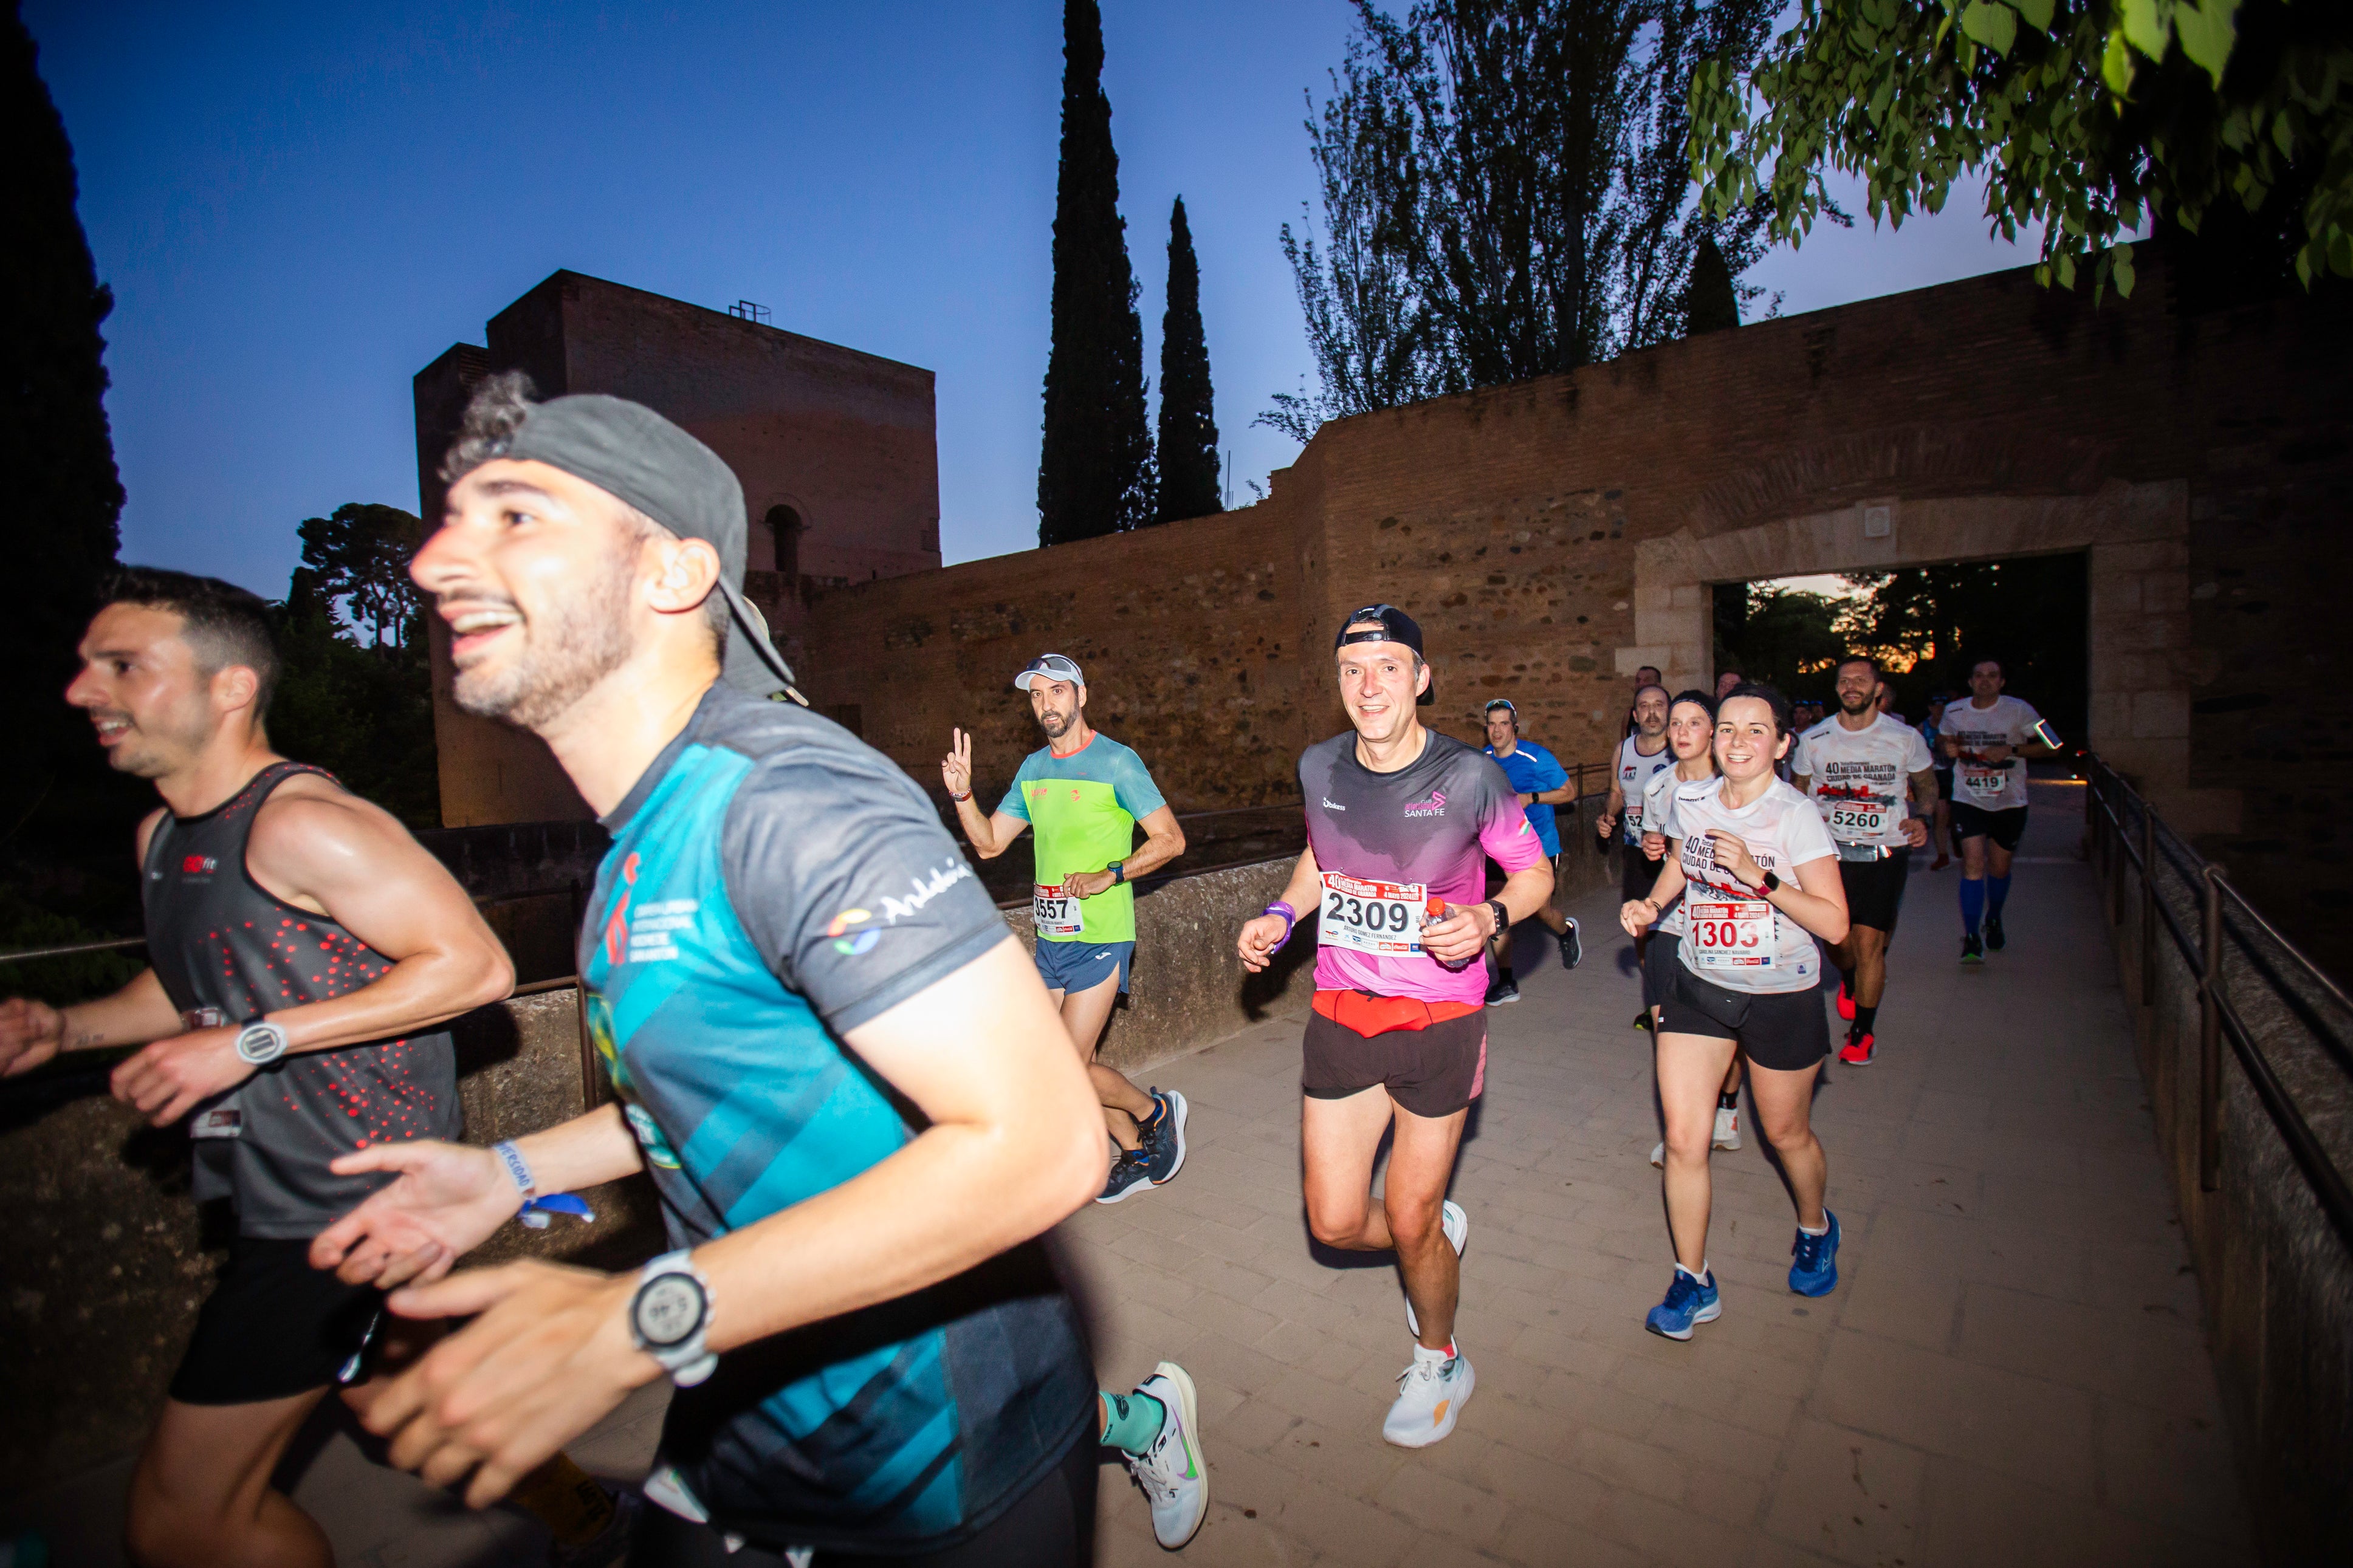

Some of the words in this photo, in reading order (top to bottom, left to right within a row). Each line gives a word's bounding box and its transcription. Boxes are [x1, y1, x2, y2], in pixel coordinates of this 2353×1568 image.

[1826, 762, 1839, 774] 40
[1863, 773, 1896, 781] GRANADA
[1966, 776, 1999, 788] 4419
[1404, 809, 1433, 818] SANTA
[1833, 810, 1880, 828] 5260
[1628, 815, 1643, 827] 52
[1685, 835, 1700, 854] 40
[1697, 846, 1716, 859] MED
[1682, 852, 1707, 869] CIUDAD
[1328, 874, 1341, 889] 40
[1341, 880, 1353, 889] MEDIA
[1354, 884, 1377, 892] MARATÓN
[1035, 897, 1068, 919] 3557
[1327, 892, 1409, 933] 2309
[1692, 905, 1700, 919] 40
[1343, 925, 1358, 935] ARTURO
[1358, 930, 1371, 938] GOMEZ
[1692, 921, 1759, 948] 1303
